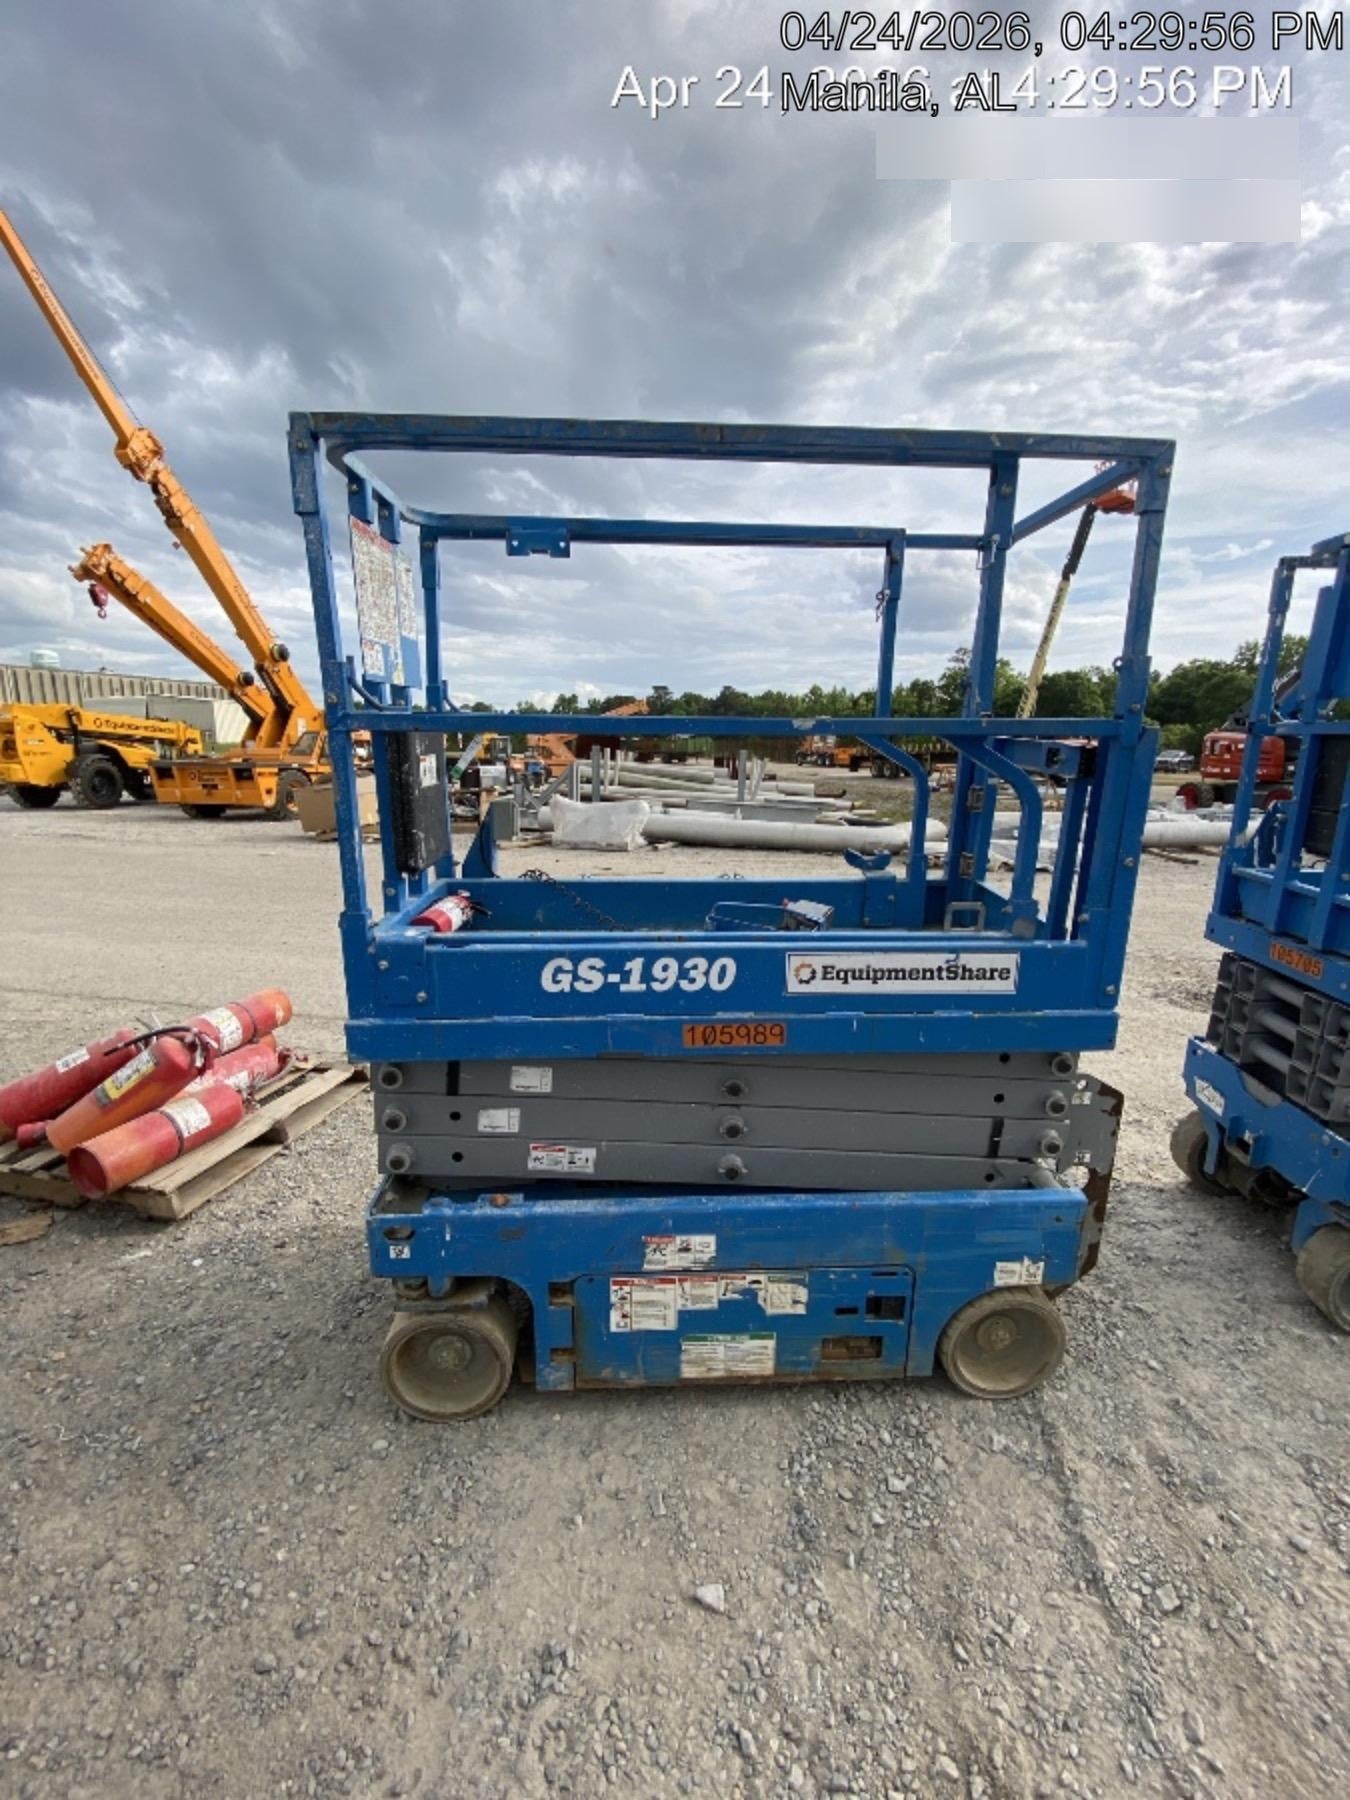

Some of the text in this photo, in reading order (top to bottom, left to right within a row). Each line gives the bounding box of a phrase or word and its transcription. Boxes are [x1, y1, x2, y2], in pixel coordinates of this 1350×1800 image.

[541, 956, 737, 993] GS-1930
[820, 963, 1012, 985] EquipmentShare
[687, 1023, 785, 1046] 105989
